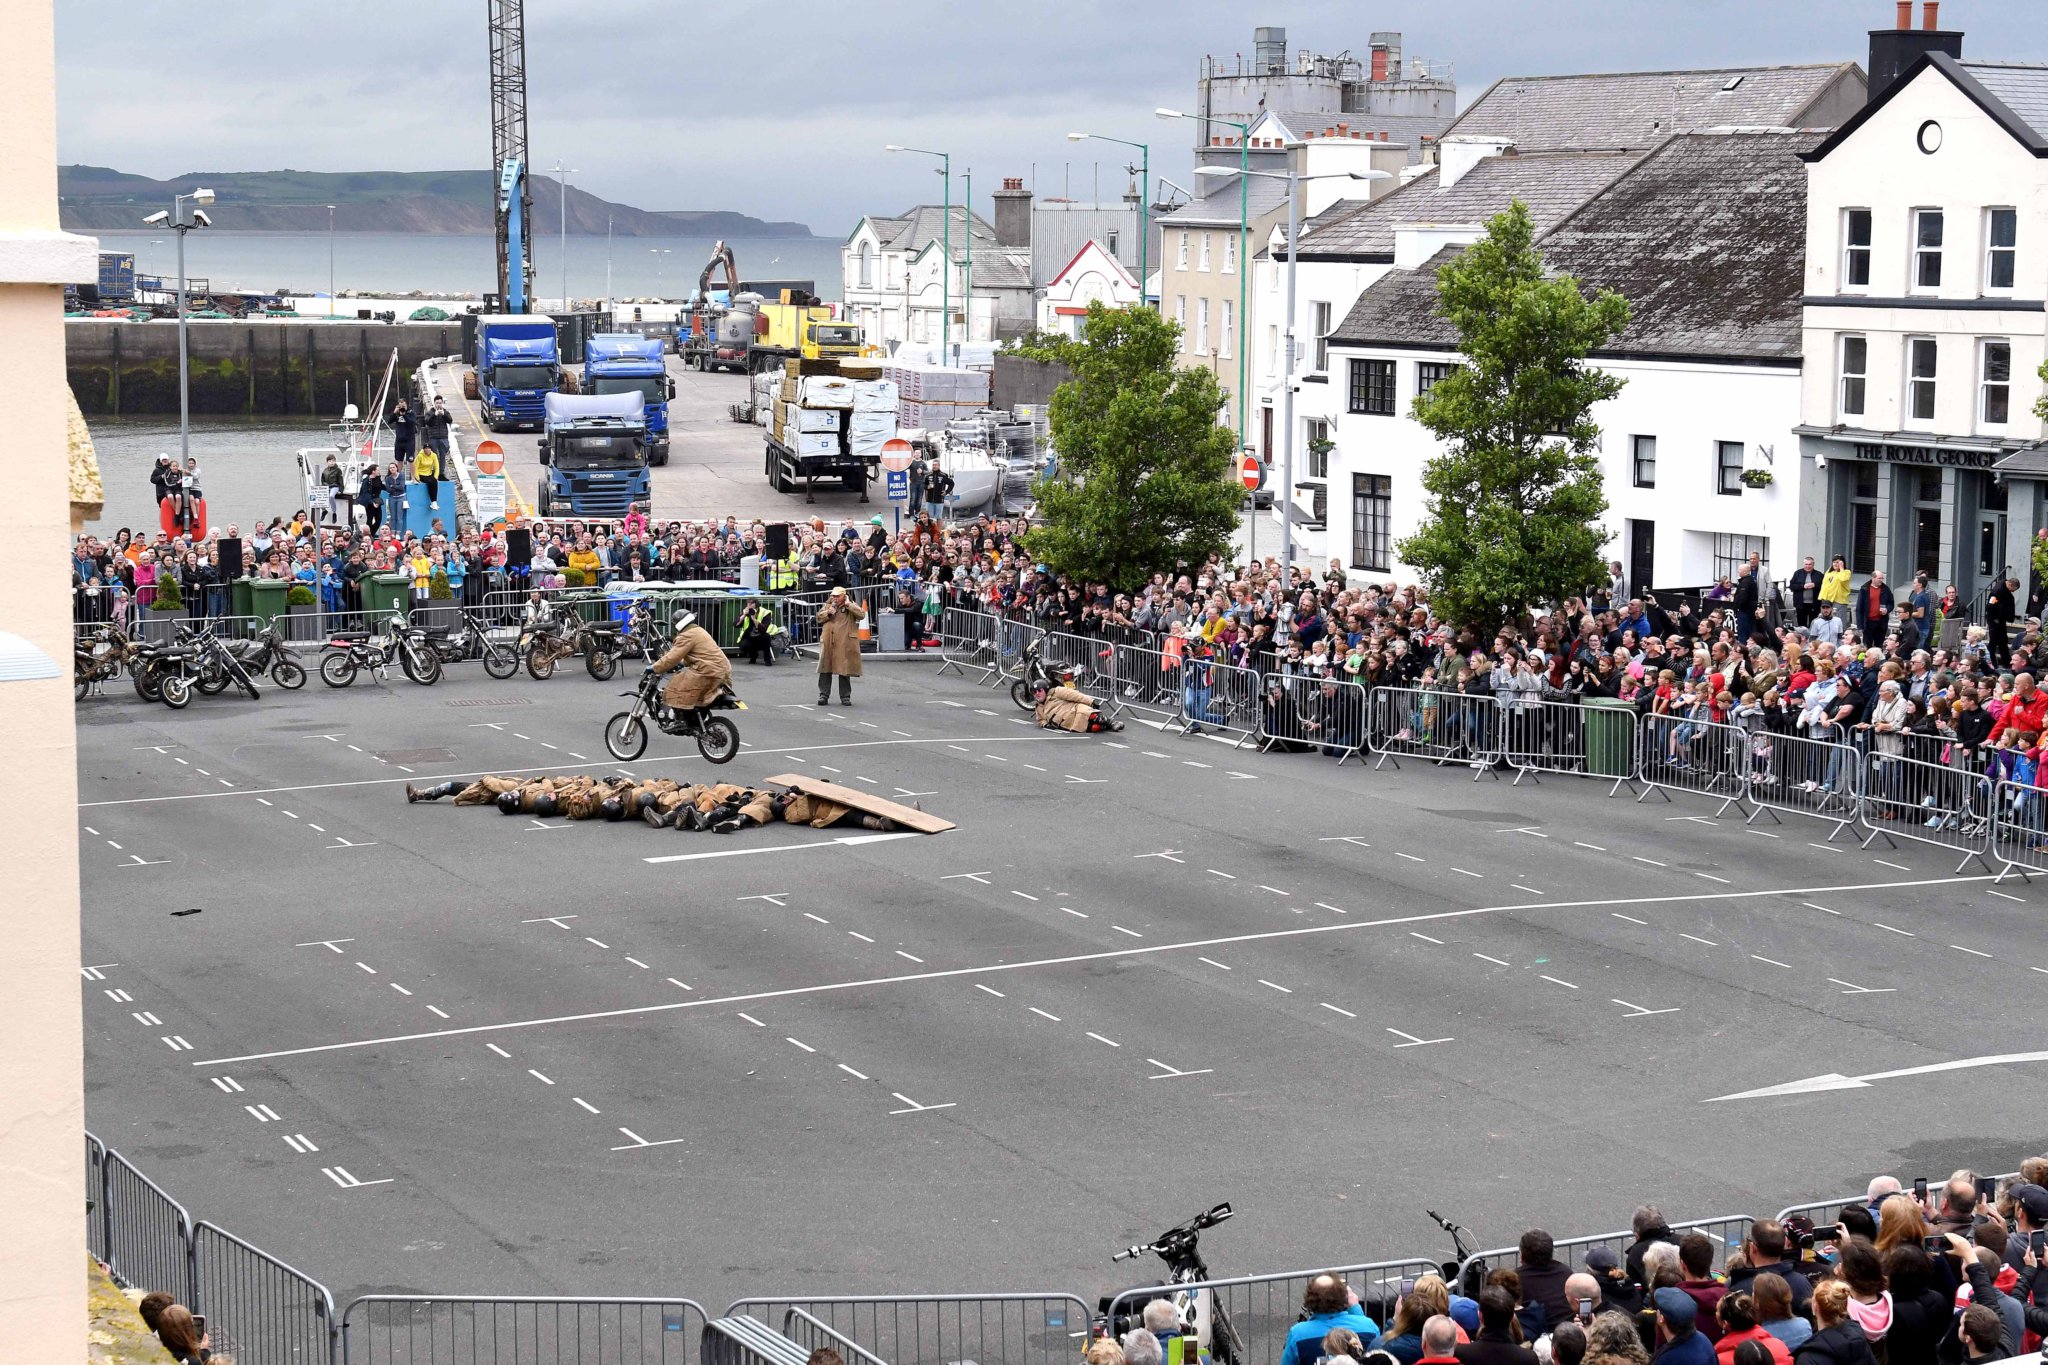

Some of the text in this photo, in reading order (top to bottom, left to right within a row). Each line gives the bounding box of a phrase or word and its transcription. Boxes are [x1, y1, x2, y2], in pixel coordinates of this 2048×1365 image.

[1854, 444, 1997, 468] THE ROYAL GEORGE
[393, 597, 400, 609] 6
